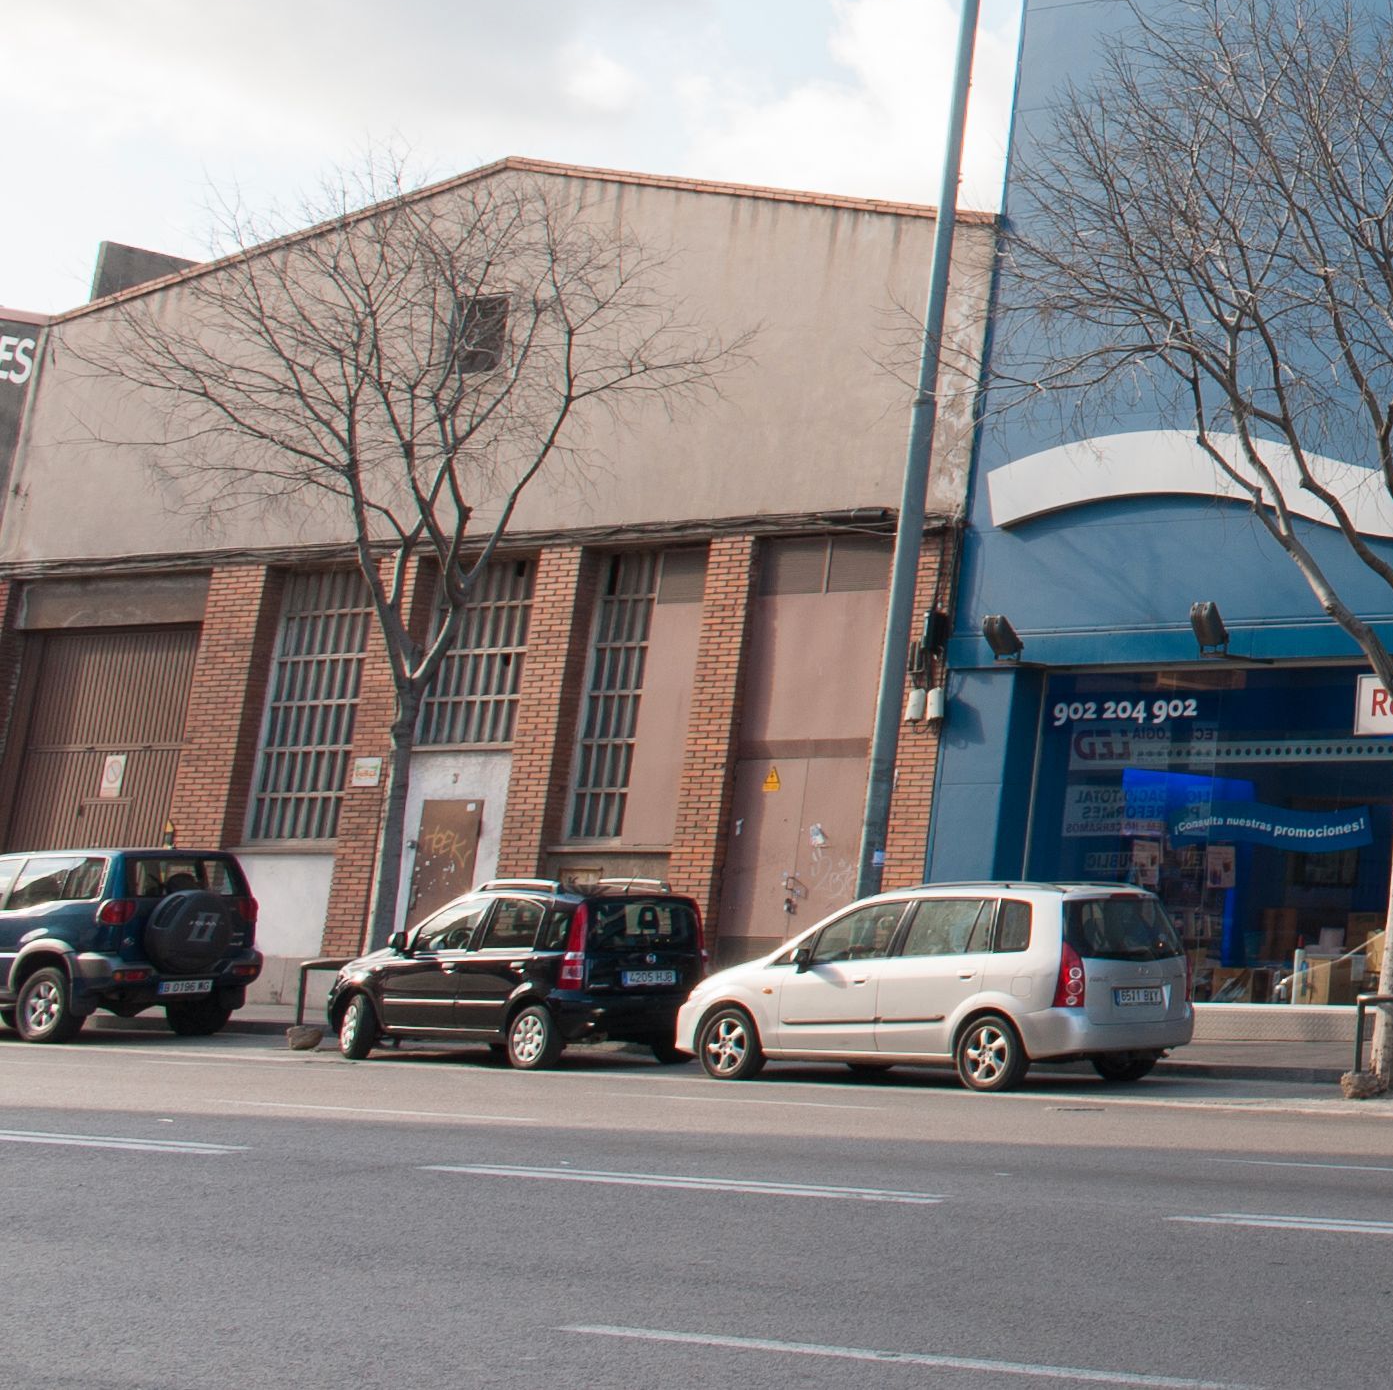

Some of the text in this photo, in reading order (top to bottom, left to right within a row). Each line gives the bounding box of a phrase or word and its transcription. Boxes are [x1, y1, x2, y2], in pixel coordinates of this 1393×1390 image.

[1053, 699, 1198, 726] 902 204 902
[1226, 817, 1272, 832] nuestras
[1273, 817, 1365, 838] promociones!
